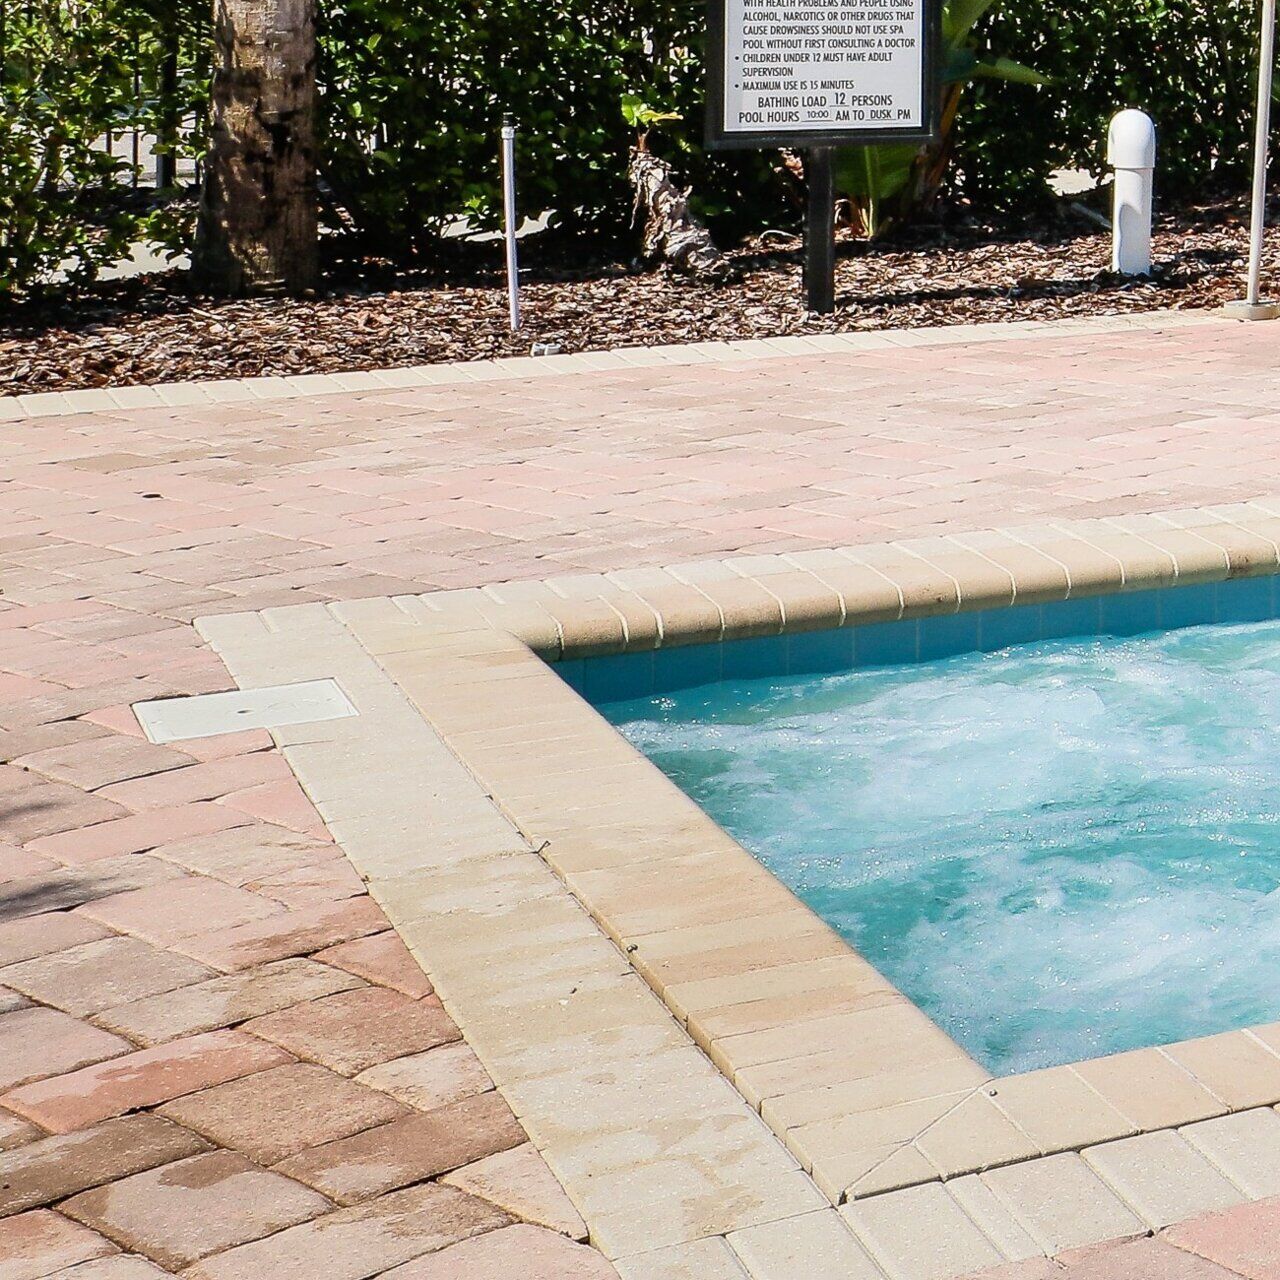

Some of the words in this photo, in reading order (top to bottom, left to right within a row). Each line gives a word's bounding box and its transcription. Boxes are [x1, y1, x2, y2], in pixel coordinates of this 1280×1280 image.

[742, 12, 781, 22] ALCOHOL,
[783, 12, 825, 21] NARCOTICS
[827, 12, 838, 21] OR
[840, 12, 865, 21] OTHER
[867, 11, 894, 21] DRUGS
[896, 11, 914, 21] THAT
[742, 26, 768, 35] CAUSE
[770, 25, 820, 35] DROWSINESS
[821, 25, 853, 34] SHOULD
[855, 25, 871, 34] NOT
[873, 25, 888, 34] USE
[889, 25, 904, 34] SPA
[742, 40, 764, 49] POOL
[766, 39, 802, 49] WITHOUT
[804, 39, 826, 48] FIRST
[827, 38, 875, 48] CONSULTING
[877, 38, 883, 48] A
[884, 38, 915, 48] DOCTOR
[742, 53, 781, 63] CHILDREN
[783, 53, 810, 62] UNDER
[813, 53, 821, 62] 12
[822, 53, 844, 62] MUST
[846, 52, 866, 62] HAVE
[868, 52, 892, 61] ADULT
[742, 67, 793, 77] SUPERVISION
[742, 81, 781, 91] MAXIMUM
[783, 81, 798, 90] USE
[800, 81, 808, 90] IS
[810, 80, 818, 90] 15
[820, 80, 854, 89] MINUTES
[758, 96, 798, 108] BATHING
[802, 96, 826, 107] LOAD
[835, 93, 845, 105] 12
[852, 95, 892, 106] PERSONS
[739, 112, 764, 123] POOL
[767, 111, 799, 122] HOURS
[835, 110, 850, 121] AM
[853, 110, 864, 120] TO
[870, 109, 892, 119] DUSK
[897, 109, 911, 119] PM
